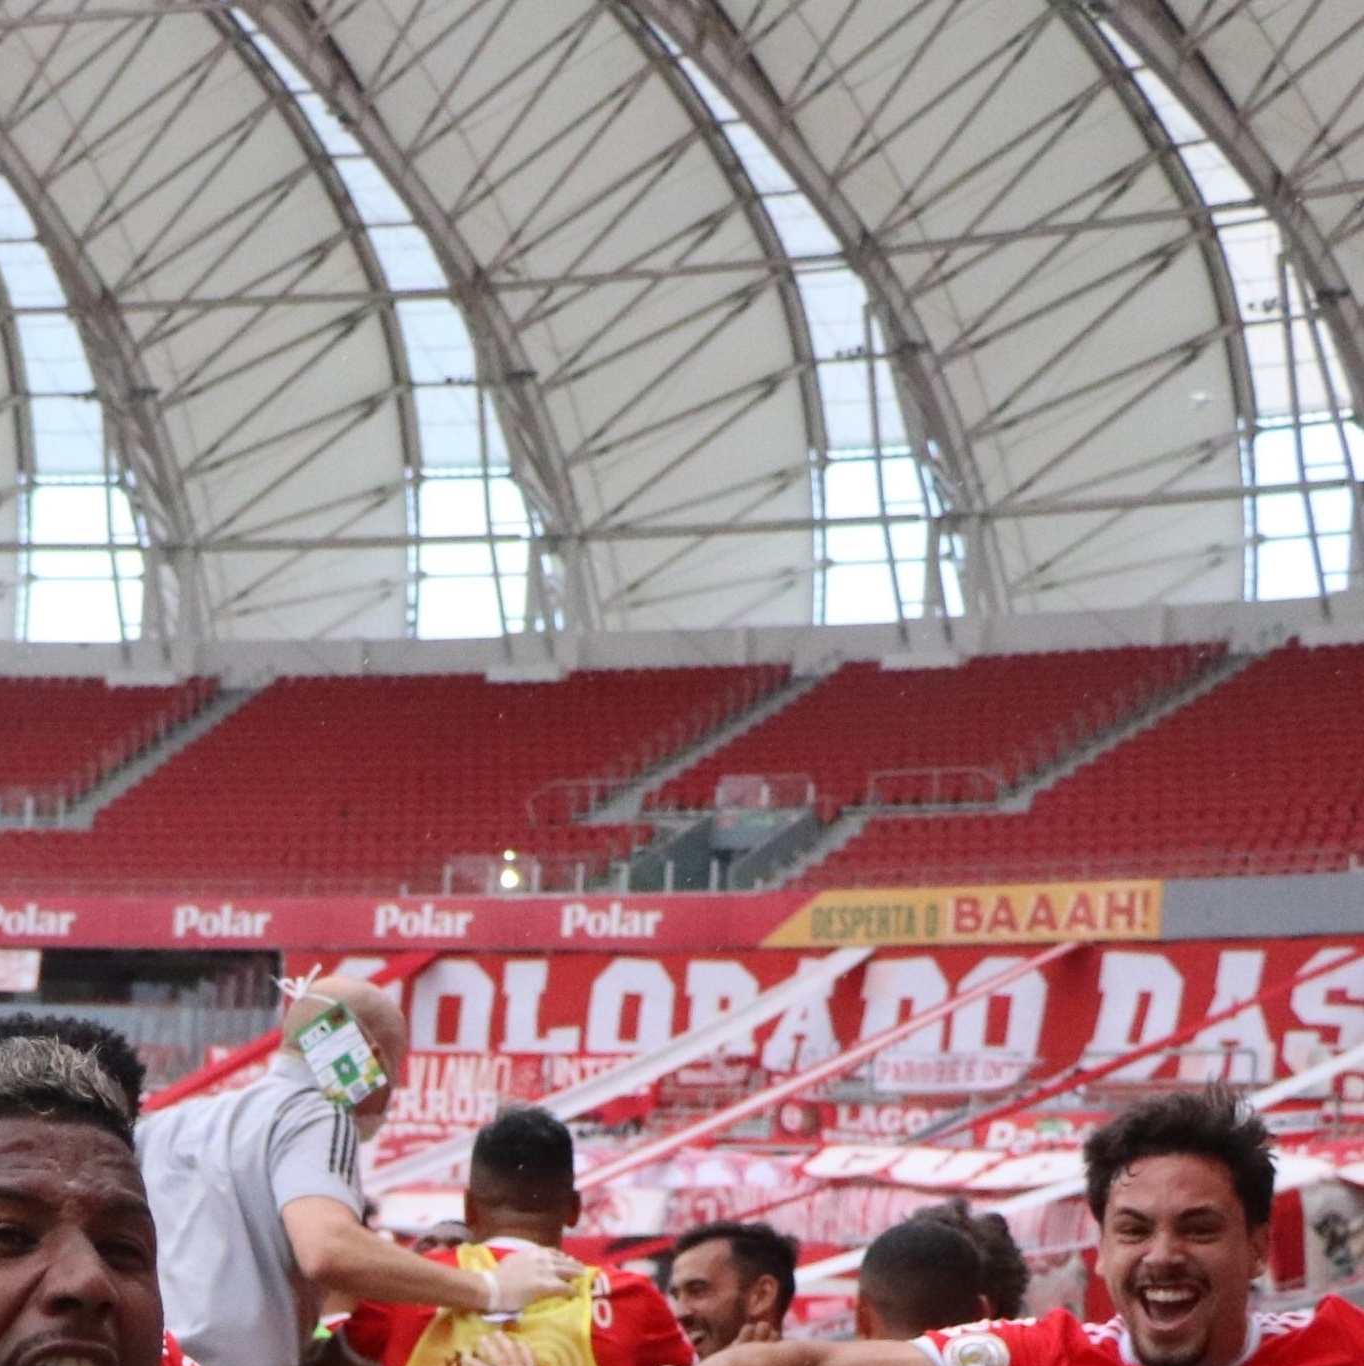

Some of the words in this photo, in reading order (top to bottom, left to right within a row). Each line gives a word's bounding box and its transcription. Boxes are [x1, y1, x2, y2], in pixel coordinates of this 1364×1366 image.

[172, 903, 272, 938] Polar
[373, 903, 474, 938] Polar
[559, 903, 664, 938] Polar
[809, 903, 922, 939] DESPERTA
[950, 891, 1154, 936] BAAAH!
